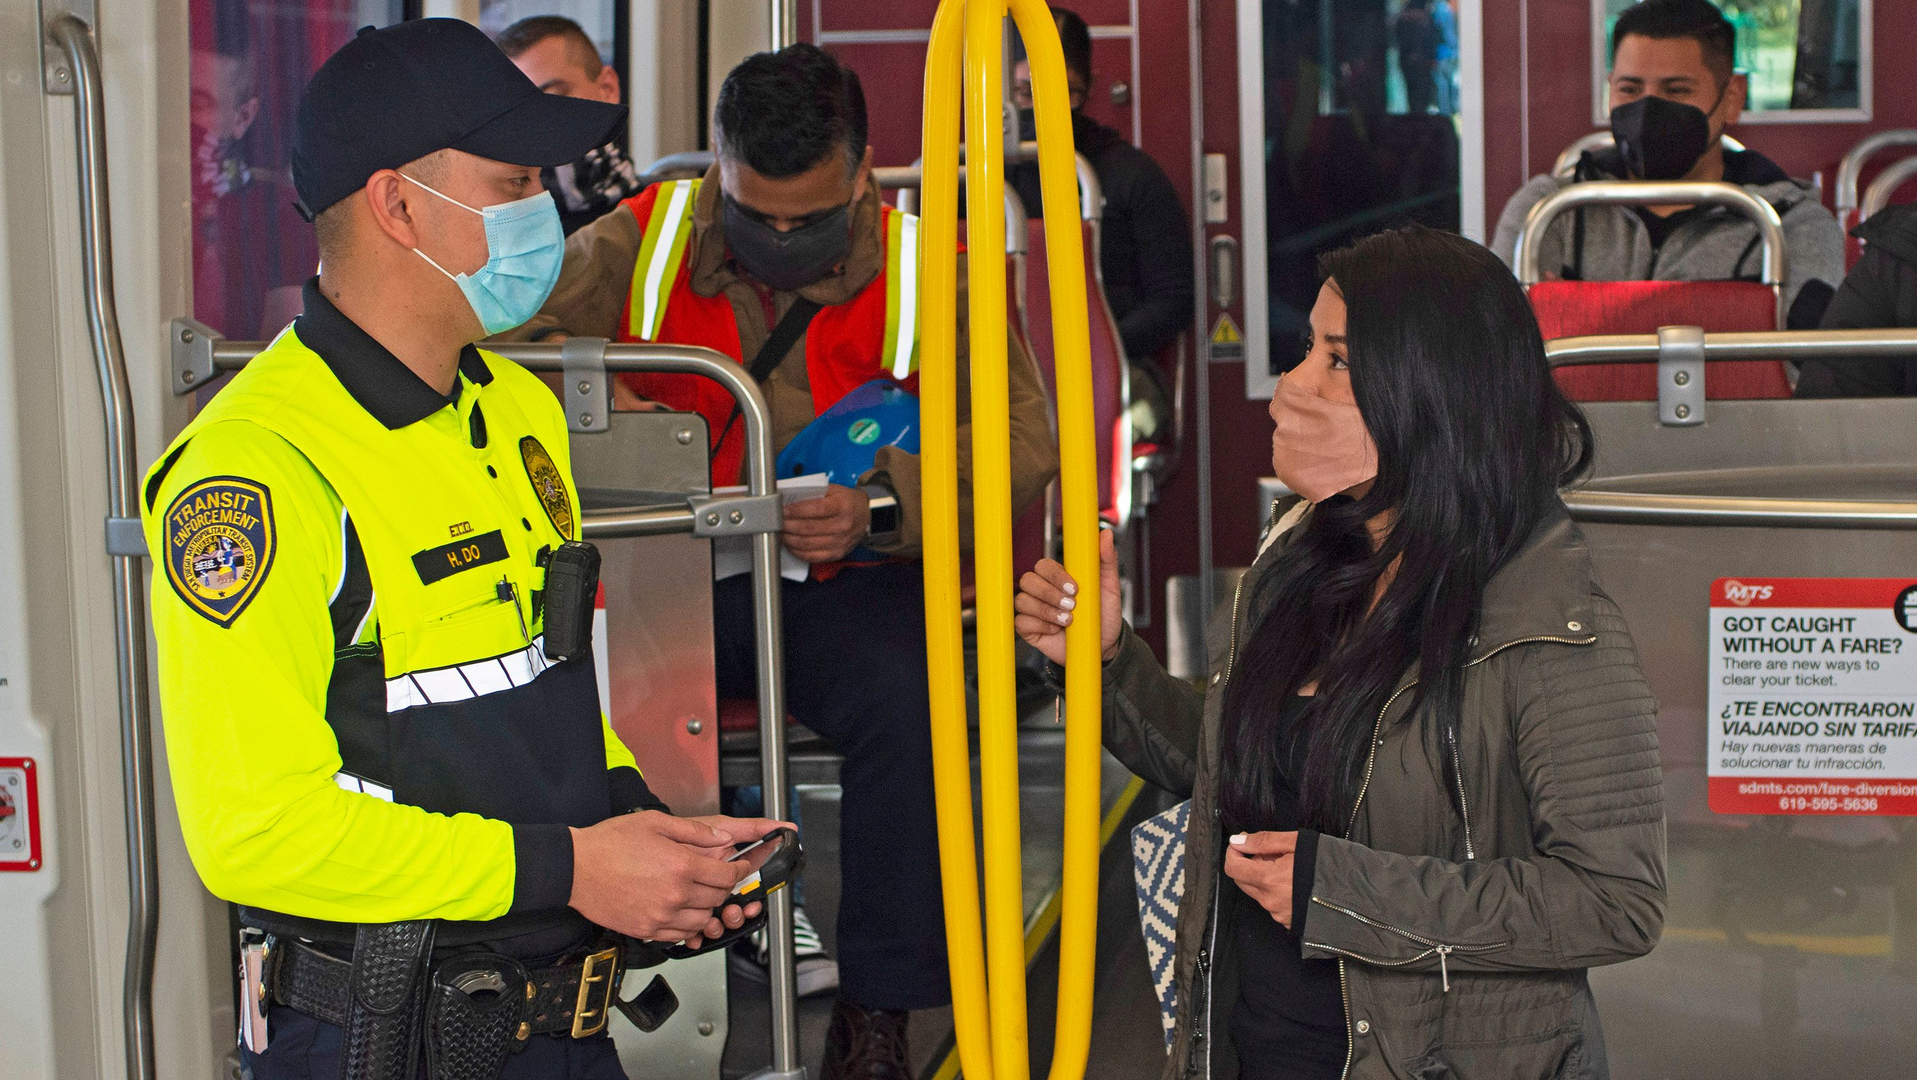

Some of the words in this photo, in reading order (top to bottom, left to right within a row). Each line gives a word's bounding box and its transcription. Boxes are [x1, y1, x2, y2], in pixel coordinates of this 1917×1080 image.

[173, 492, 254, 526] TRANSIT
[173, 510, 260, 547] ENFORCEMENT
[187, 526, 228, 556] METROPOLITAN
[228, 528, 252, 552] TRANSIT
[446, 551, 463, 568] H.
[461, 544, 480, 563] DO
[184, 558, 193, 577] DIEGO
[241, 553, 254, 581] SYSTEM
[188, 576, 201, 591] SAN
[1725, 584, 1775, 600] MTS
[1723, 616, 1766, 633] GOT
[1771, 616, 1857, 634] CAUGHT
[1723, 637, 1818, 653] WITHOUT
[1821, 638, 1836, 653] A
[1841, 638, 1903, 654] FARE?
[1723, 657, 1762, 670] There
[1766, 660, 1788, 671] are
[1793, 660, 1822, 671] new
[1826, 660, 1862, 674] ways
[1865, 659, 1880, 671] to
[1722, 673, 1756, 686] clear
[1761, 676, 1792, 689] your
[1796, 674, 1838, 687] ticket.
[1721, 701, 1758, 719] ¿TE
[1762, 701, 1915, 718] ENCONTRARON
[1722, 721, 1819, 737] VIAJANDO
[1824, 722, 1857, 737] SIN
[1721, 741, 1749, 755] Hay
[1752, 743, 1801, 754] nuevas
[1805, 744, 1866, 754] maneras
[1869, 742, 1888, 754] de
[1721, 757, 1792, 769] solucionar
[1797, 758, 1810, 770] tu
[1814, 757, 1887, 770] infracción.
[1779, 798, 1878, 811] 619-595-5636
